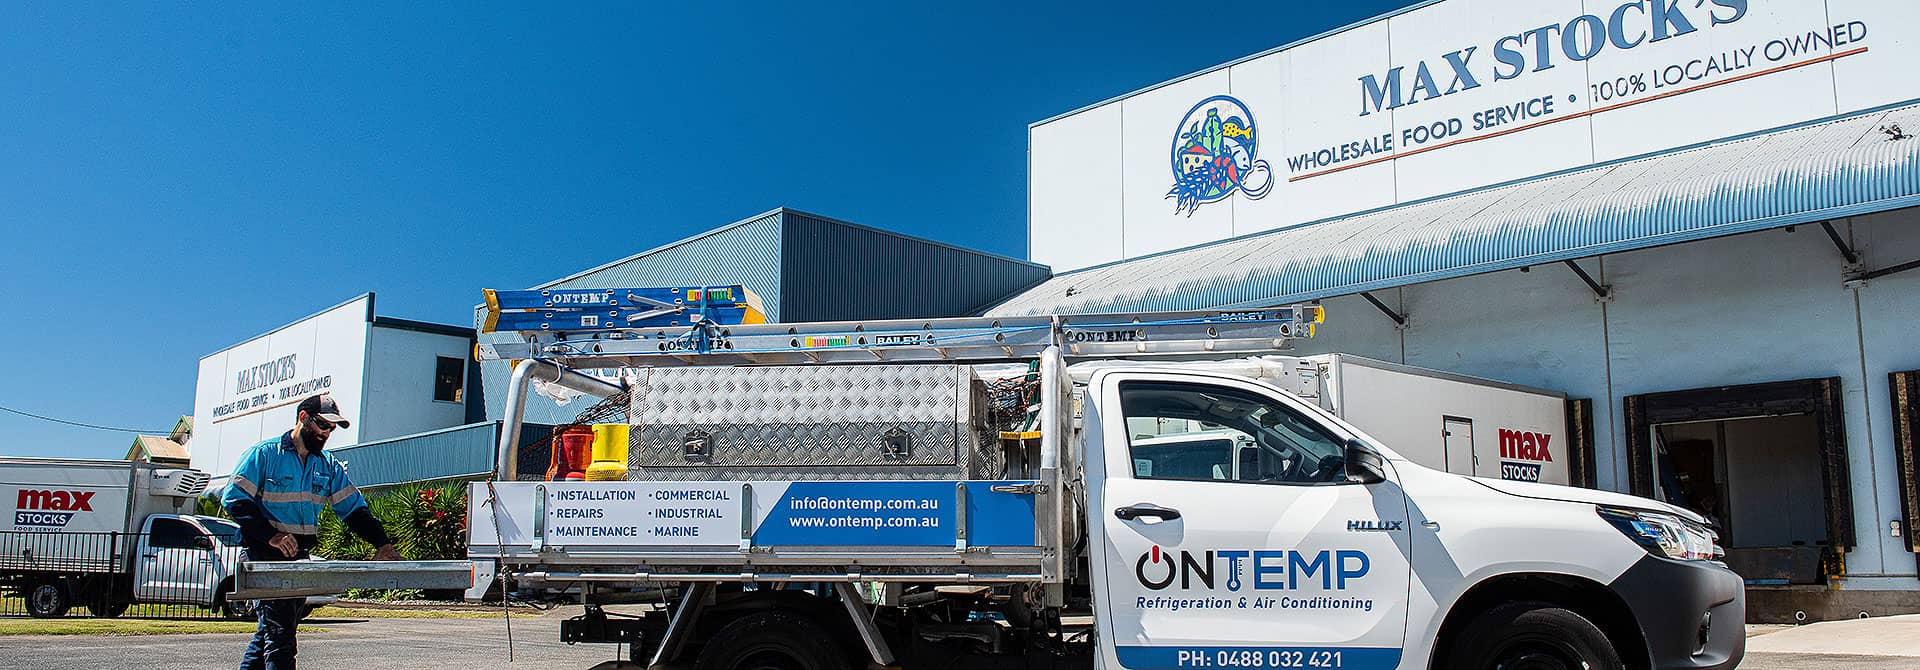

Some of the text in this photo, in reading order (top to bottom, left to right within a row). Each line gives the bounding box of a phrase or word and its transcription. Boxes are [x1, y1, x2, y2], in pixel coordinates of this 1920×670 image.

[1358, 46, 1481, 116] MAX
[1287, 20, 1868, 173] WHOLESALE FOOD SERVICE 100% LOCALLY OWNED
[552, 292, 609, 304] ONTEMP
[876, 335, 920, 346] BAILEY
[1075, 331, 1136, 342] ONTEMP
[236, 366, 258, 395] MAX
[1498, 428, 1553, 462] max
[1502, 464, 1538, 481] STOCKS
[16, 489, 96, 512] max
[557, 490, 636, 501] INSTALLATION
[655, 490, 730, 501] COMMERCIAL
[790, 496, 938, 513] info@ontemp.com.au
[17, 512, 67, 525] STOCKS
[556, 508, 604, 519] REPAIRS
[655, 508, 723, 519] INDUSTRIAL
[789, 515, 939, 530] www.ontemp.com.au
[1347, 519, 1402, 531] HILUX
[556, 526, 638, 537] MAINTENANCE
[654, 526, 699, 537] MARINE
[1136, 545, 1371, 591] ONTEMP
[1136, 597, 1373, 611] Refrigeration & Air Conditioning
[1178, 650, 1342, 667] PH: 0488 032 421
